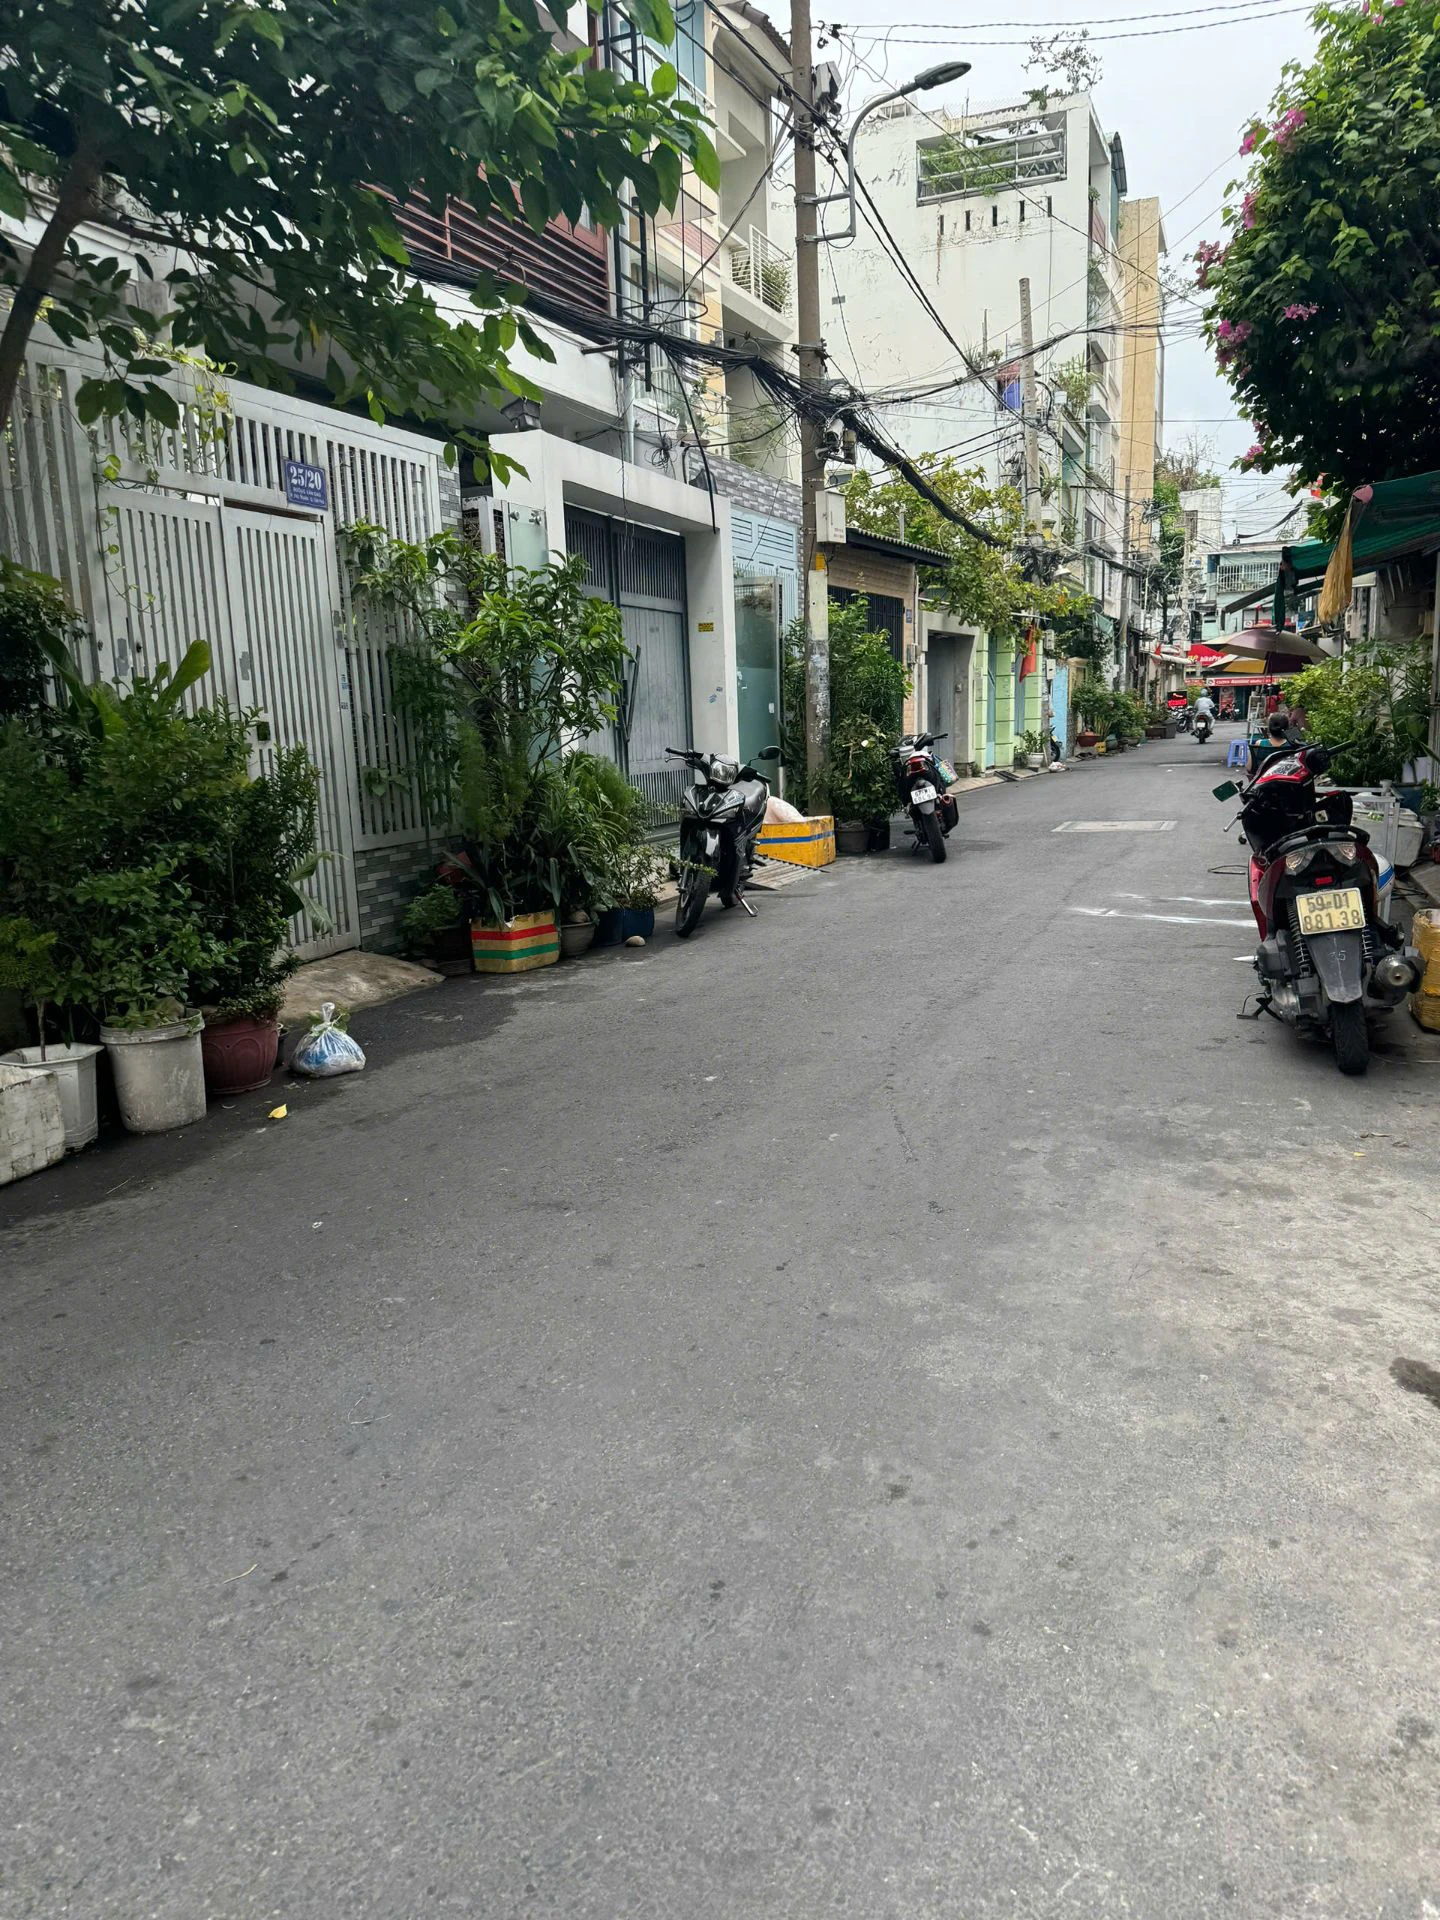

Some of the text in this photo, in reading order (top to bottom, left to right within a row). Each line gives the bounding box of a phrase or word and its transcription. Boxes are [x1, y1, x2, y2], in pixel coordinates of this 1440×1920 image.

[290, 465, 321, 490] 25/20
[1306, 892, 1350, 914] 59-D1
[1303, 909, 1361, 931] 881.38
